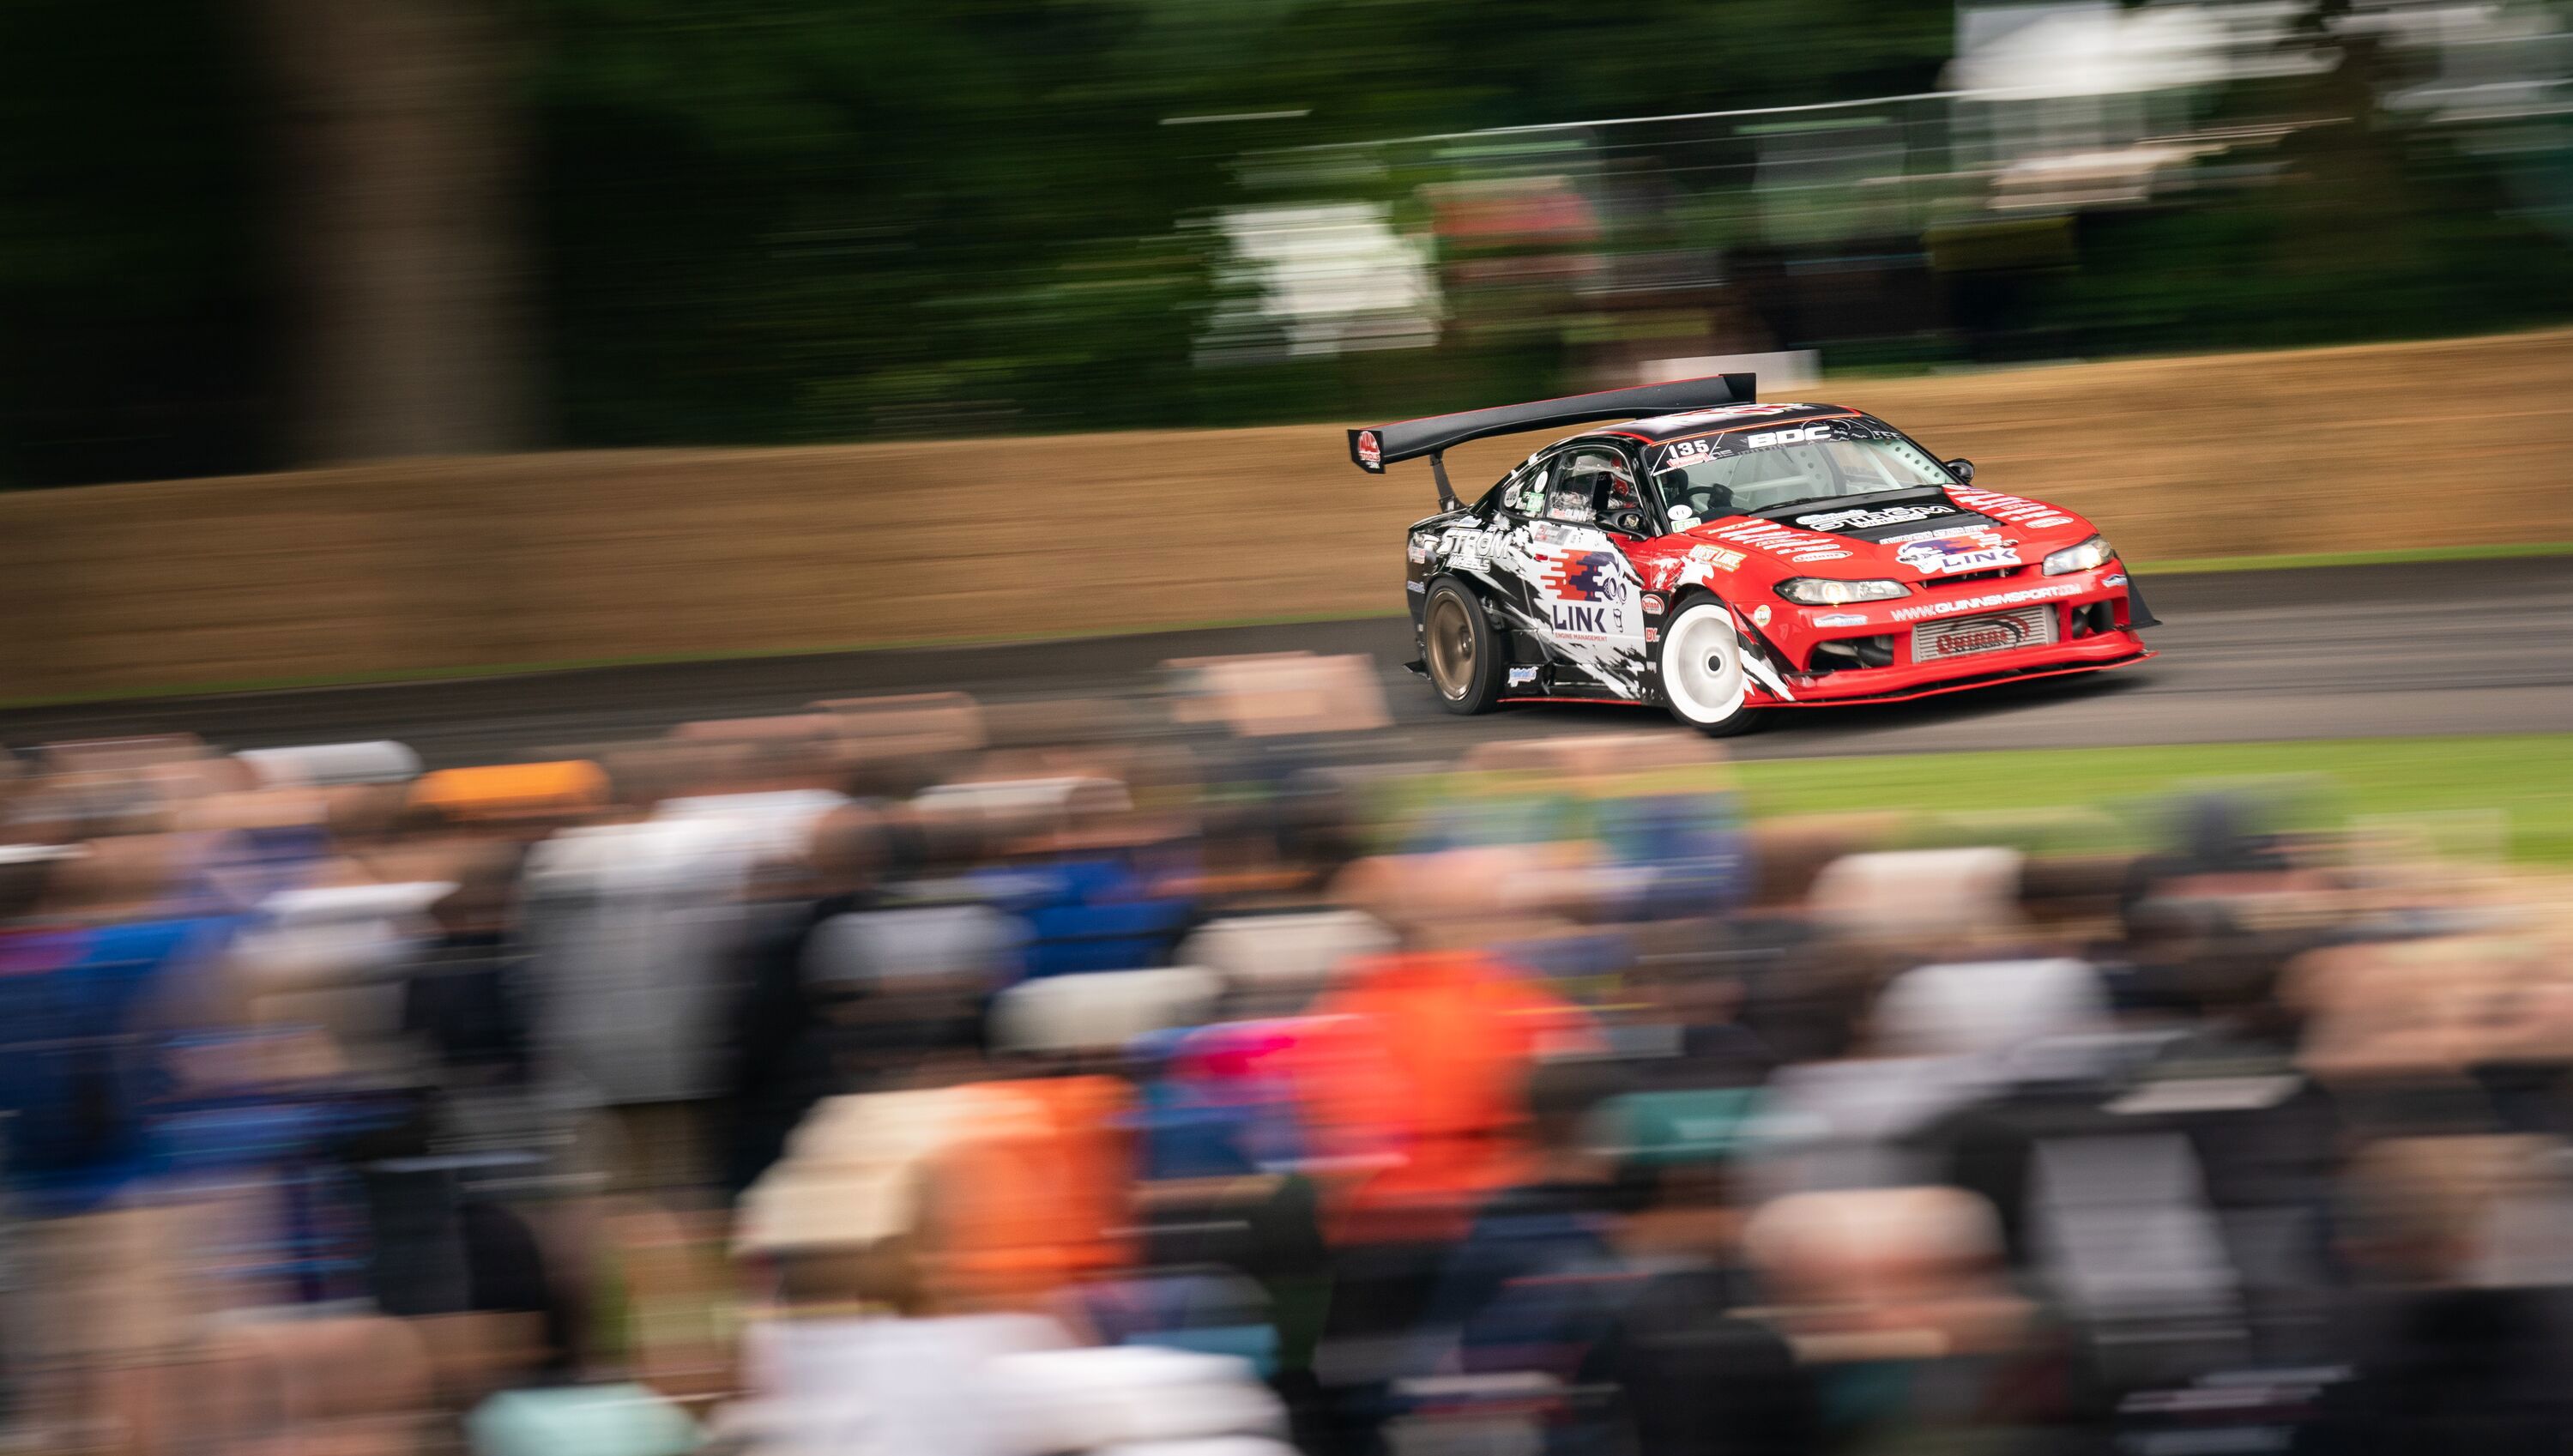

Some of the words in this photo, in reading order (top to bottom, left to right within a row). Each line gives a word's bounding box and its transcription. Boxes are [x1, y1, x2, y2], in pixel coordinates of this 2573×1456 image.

[1748, 426, 1832, 449] BDC
[1668, 439, 1710, 461] 135
[1942, 550, 2016, 569] LINK
[1553, 604, 1607, 633] LINK
